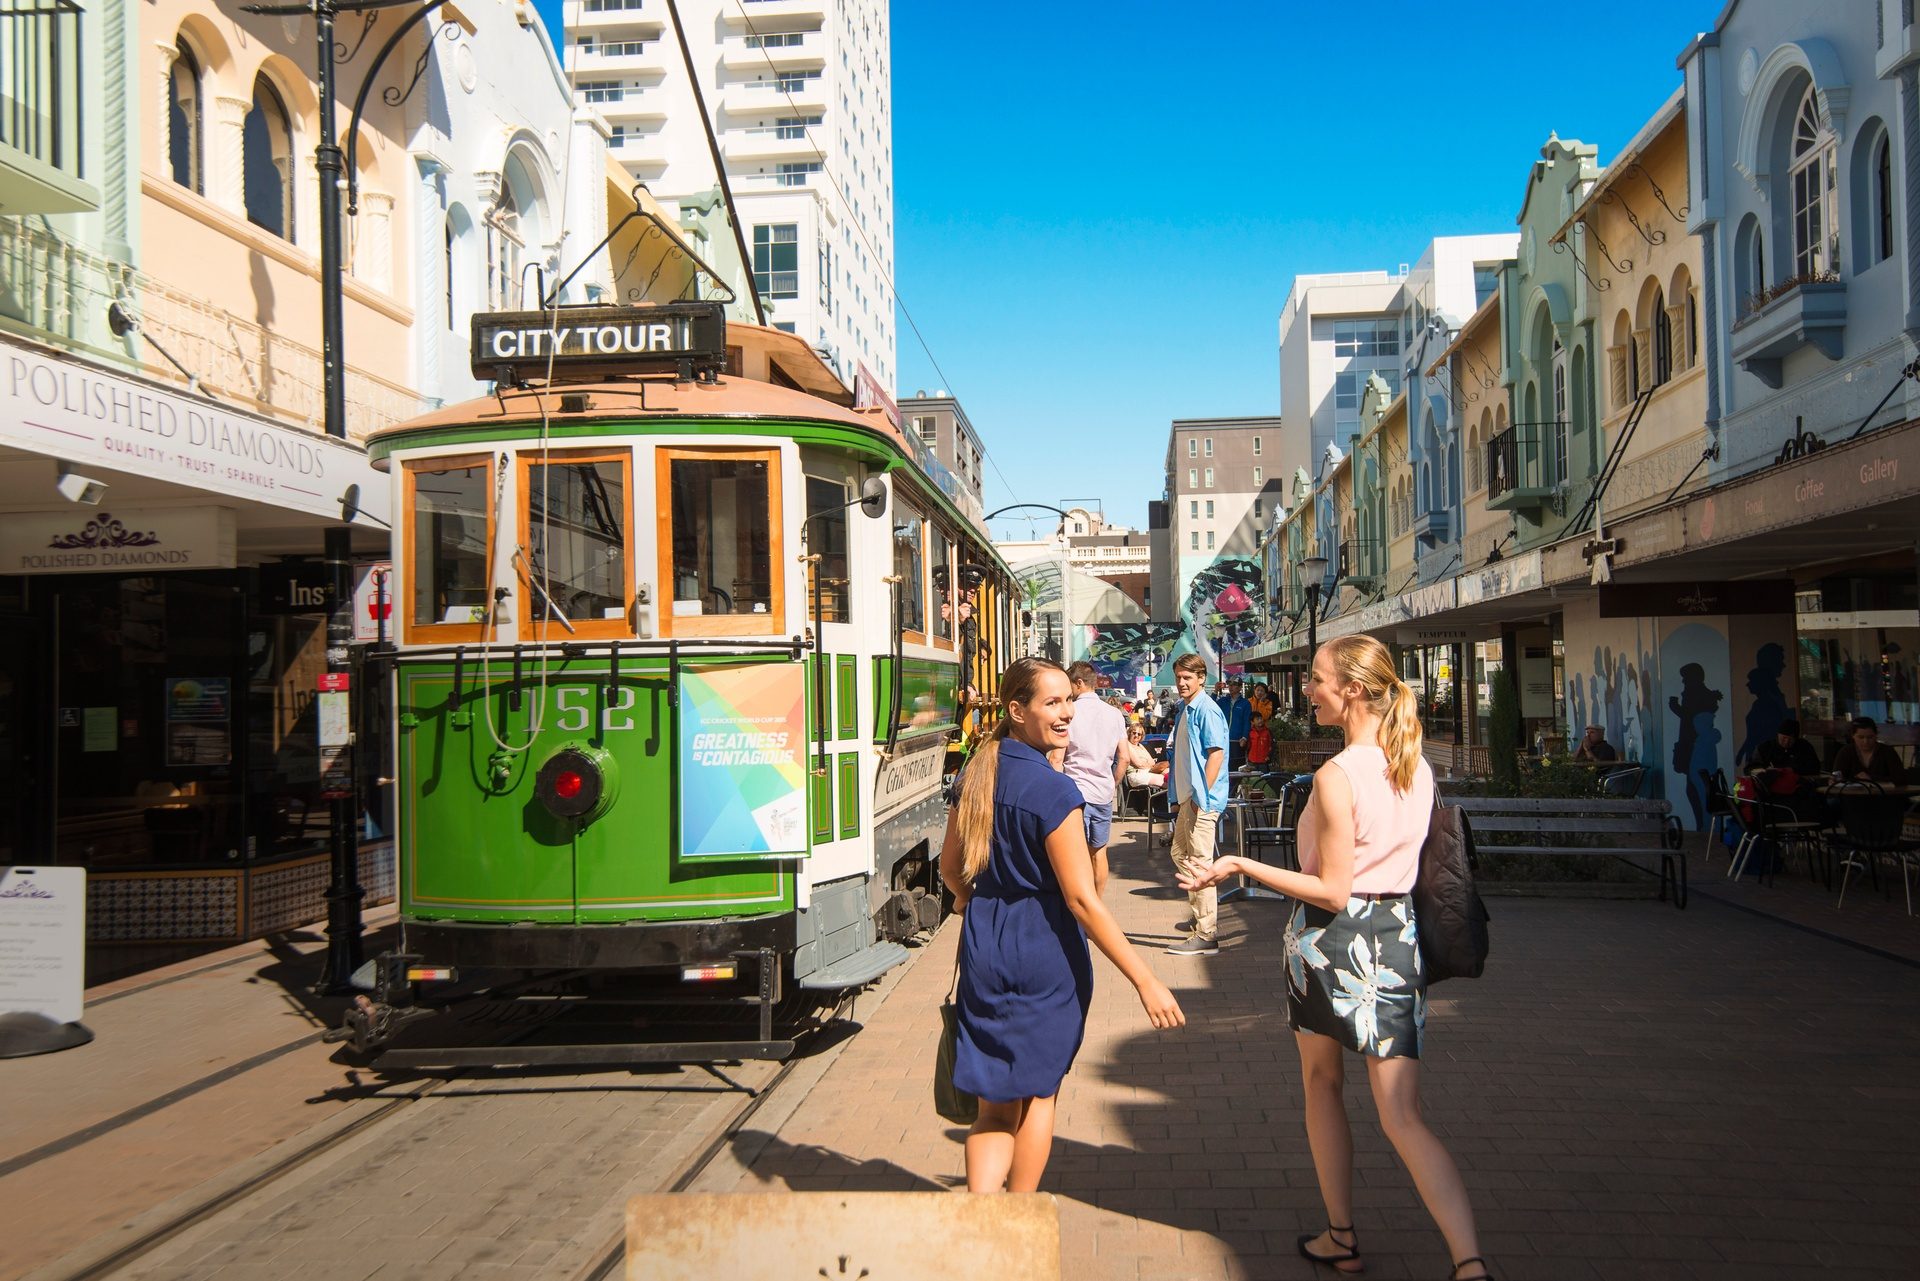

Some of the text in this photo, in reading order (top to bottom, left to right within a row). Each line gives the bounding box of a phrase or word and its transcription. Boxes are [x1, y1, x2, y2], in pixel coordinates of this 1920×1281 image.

[492, 324, 673, 358] CITY TOUR
[10, 356, 325, 478] POLISHED DIAMONDS
[104, 436, 275, 490] QUALITY TRUST SPARKLE
[1744, 458, 1899, 517] Food Coffee Gallery
[21, 551, 191, 569] POLISHED DIAMONDS
[290, 579, 327, 606] Ins
[692, 731, 789, 750] GREATNESS
[692, 749, 795, 767] IS CONTAGIOUS
